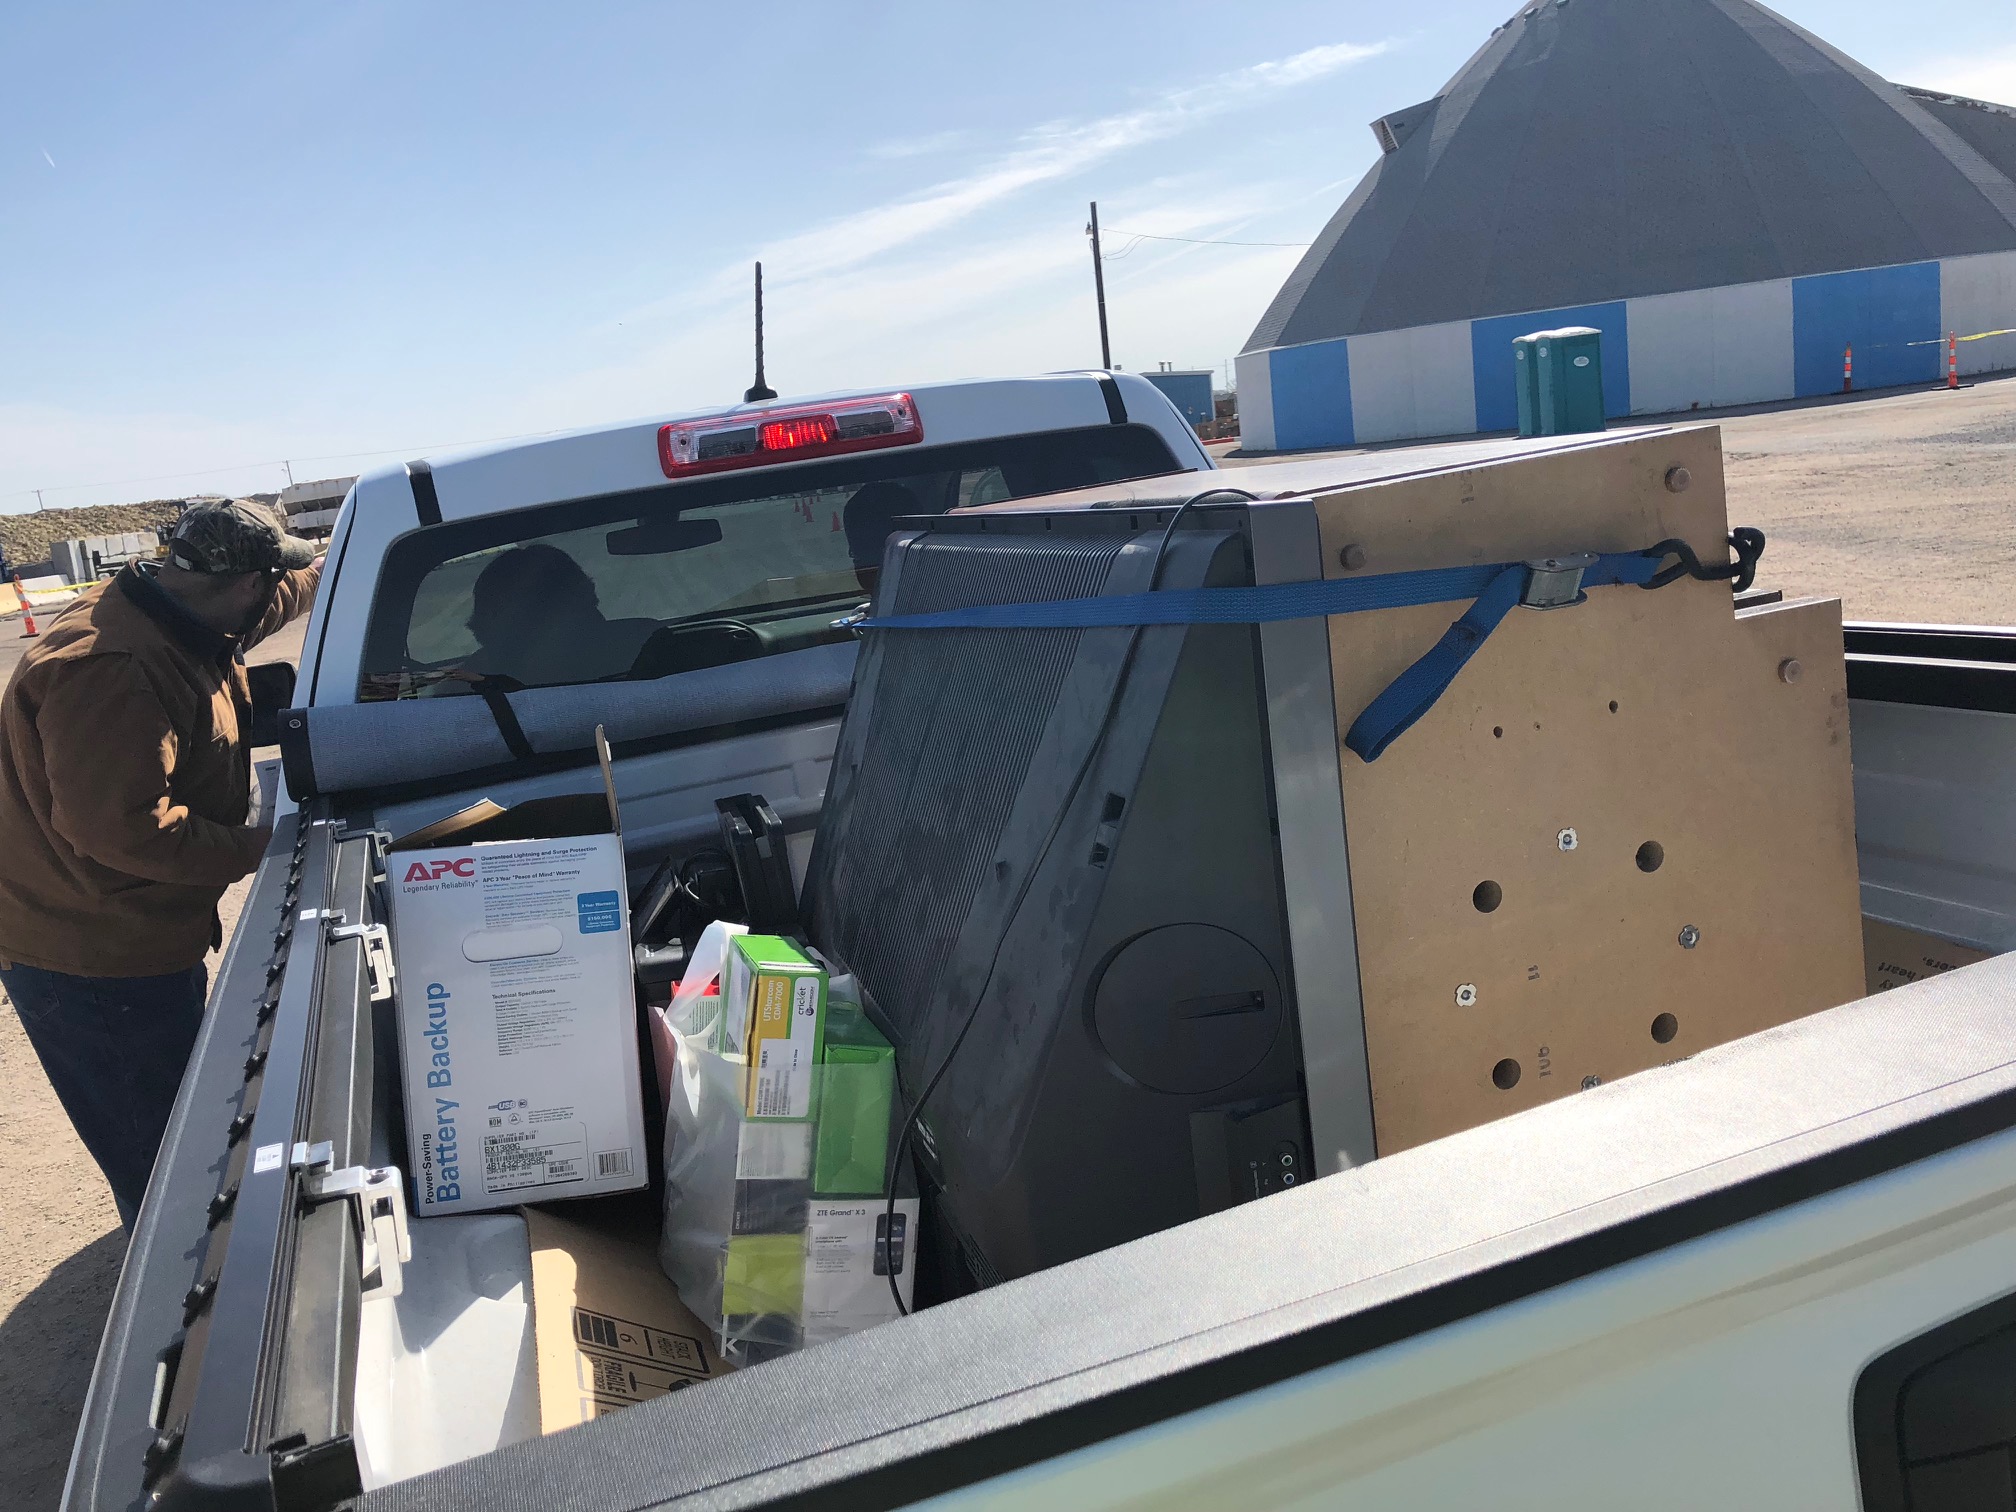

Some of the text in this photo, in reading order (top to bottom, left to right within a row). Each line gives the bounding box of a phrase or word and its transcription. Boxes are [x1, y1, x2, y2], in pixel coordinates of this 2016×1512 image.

[403, 857, 476, 883] APC
[481, 853, 513, 861] Guaranteed
[514, 851, 540, 859] Lightning
[403, 881, 440, 894] Legendary
[492, 989, 556, 1000] Technical Specifications
[763, 980, 775, 1022] UTStarcom
[774, 981, 784, 1021] CDM-7000
[798, 986, 807, 1016] cricket
[423, 982, 461, 1203] Battery Backup
[498, 1101, 516, 1110] USB
[422, 1133, 435, 1205] Power-Saving
[619, 1333, 638, 1346] 6
[603, 1360, 627, 1394] FRAGILE
